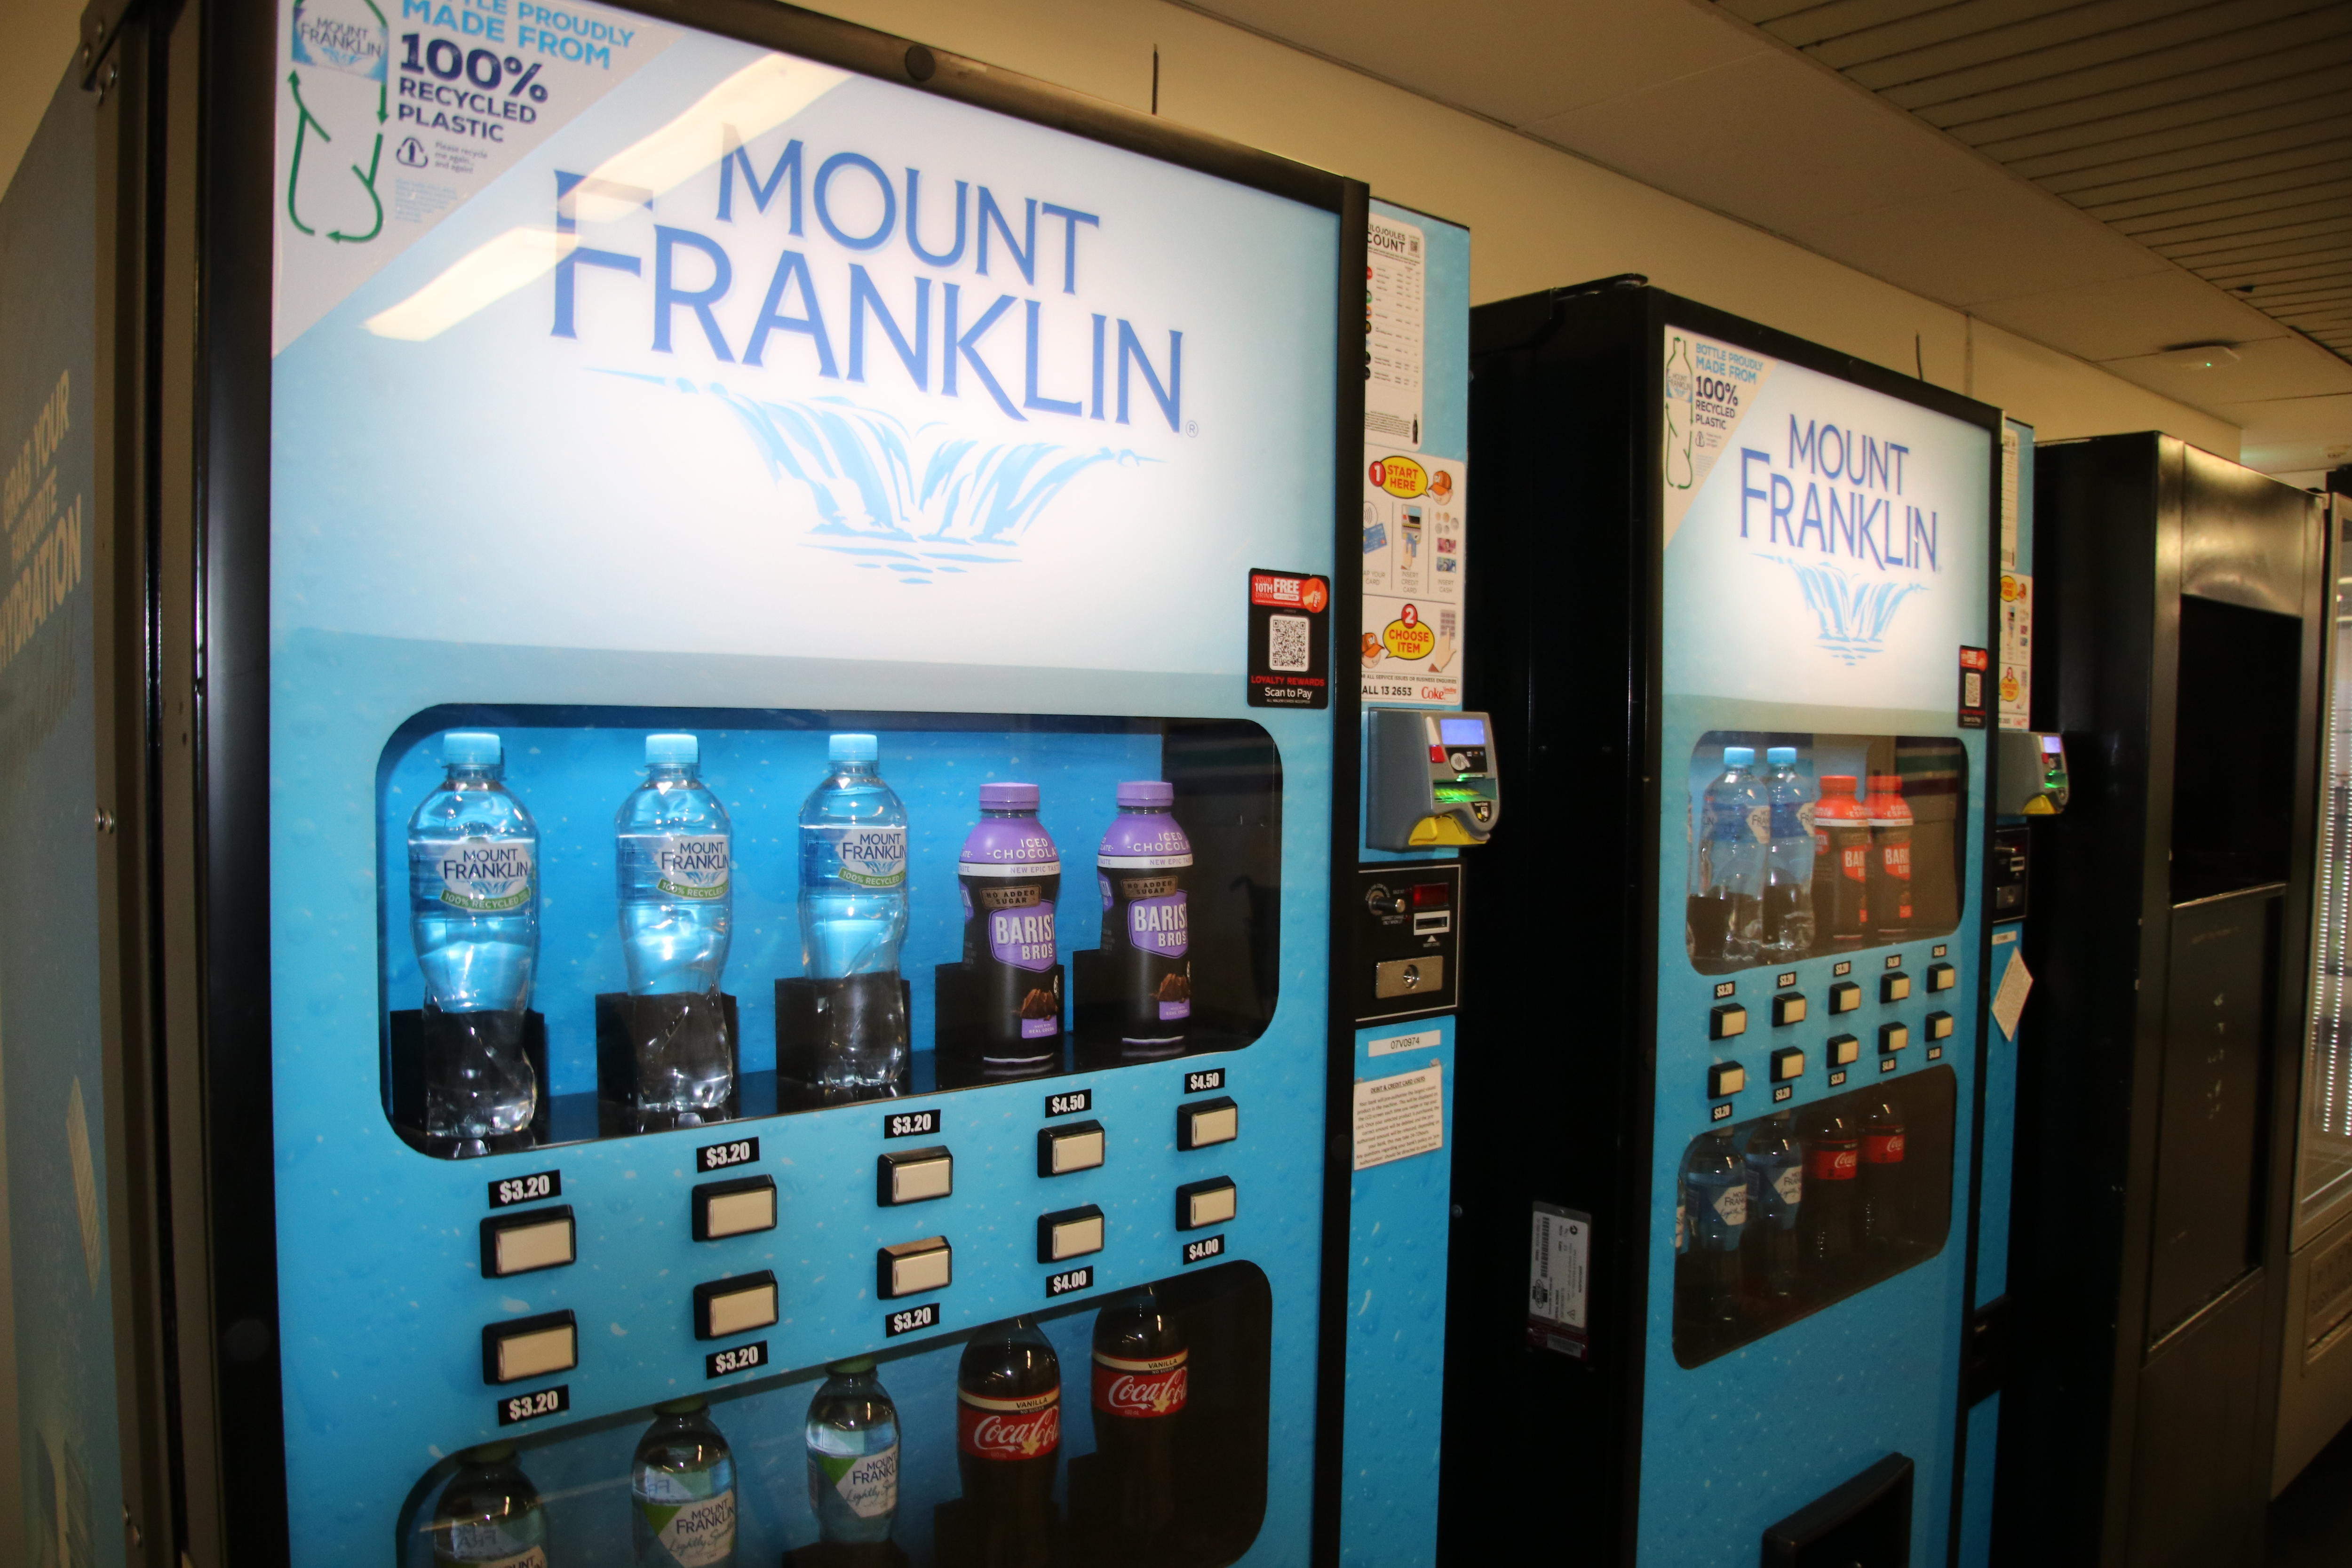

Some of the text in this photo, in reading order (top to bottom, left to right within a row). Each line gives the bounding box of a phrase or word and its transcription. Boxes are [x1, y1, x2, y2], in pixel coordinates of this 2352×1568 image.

[318, 17, 368, 40] MOUNT
[518, 2, 635, 48] PROUDLY
[301, 22, 381, 57] FRANKLIN
[403, 0, 610, 70] MADE FROM
[400, 32, 549, 103] 100%
[399, 76, 537, 125] RECYCLED
[398, 103, 504, 143] PLASTIC
[435, 142, 488, 159] Please recycle
[716, 123, 1099, 295] MOUNT
[550, 168, 1183, 434] FRANKLIN
[1696, 343, 1764, 372] BOTTLE PROUDLY
[1696, 356, 1756, 385] MADE FROM
[1696, 376, 1738, 406] 100%
[1695, 399, 1735, 419] RECYCLED
[34, 369, 70, 477] YOUR
[1695, 414, 1726, 430] PLASTIC
[1788, 414, 1908, 495] MOUNT
[1388, 465, 1419, 479] START
[1390, 478, 1416, 491] HERE
[1740, 447, 1937, 573] FRANKLIN
[1255, 583, 1273, 593] 10TH
[1273, 578, 1300, 595] FREE
[1406, 607, 1414, 624] 2
[1388, 629, 1430, 643] CHOOSE
[1397, 641, 1420, 654] ITEM
[1251, 676, 1325, 686] LOYALTY REWARDS
[1264, 687, 1312, 700] Scan to Pay
[1381, 686, 1389, 695] 13
[1391, 686, 1412, 696] 2653
[1421, 686, 1445, 700] Coke
[860, 834, 901, 845] MOUNT
[1020, 838, 1048, 848] ICED
[1159, 832, 1183, 842] ICED
[463, 848, 518, 862] MOUNT
[680, 842, 724, 854] MOUNT
[444, 860, 528, 880] FRANKLIN
[842, 871, 900, 885] 100% RECYCLED
[662, 882, 723, 897] 100% RECYCLED
[1004, 889, 1035, 898] ADDED
[445, 893, 519, 909] 100% RECYCLED
[1391, 1036, 1420, 1050] 07V0974
[1190, 1072, 1220, 1091] $4.50
[1371, 1085, 1382, 1094] DEBIT
[1388, 1082, 1401, 1090] CREDIT
[1052, 1093, 1085, 1114] $4.50
[893, 1113, 932, 1135] $3.20
[706, 1141, 750, 1168] $3.20
[500, 1175, 550, 1204] $3.20
[1189, 1238, 1219, 1260] $4.00
[1053, 1270, 1087, 1293] $4.00
[893, 1306, 931, 1332] $3.20
[715, 1345, 759, 1374] $3.20
[1149, 1358, 1177, 1369] VANILLA
[509, 1390, 559, 1421] $3.20
[1016, 1397, 1048, 1409] VANILLA
[691, 1498, 729, 1520] MOUNT
